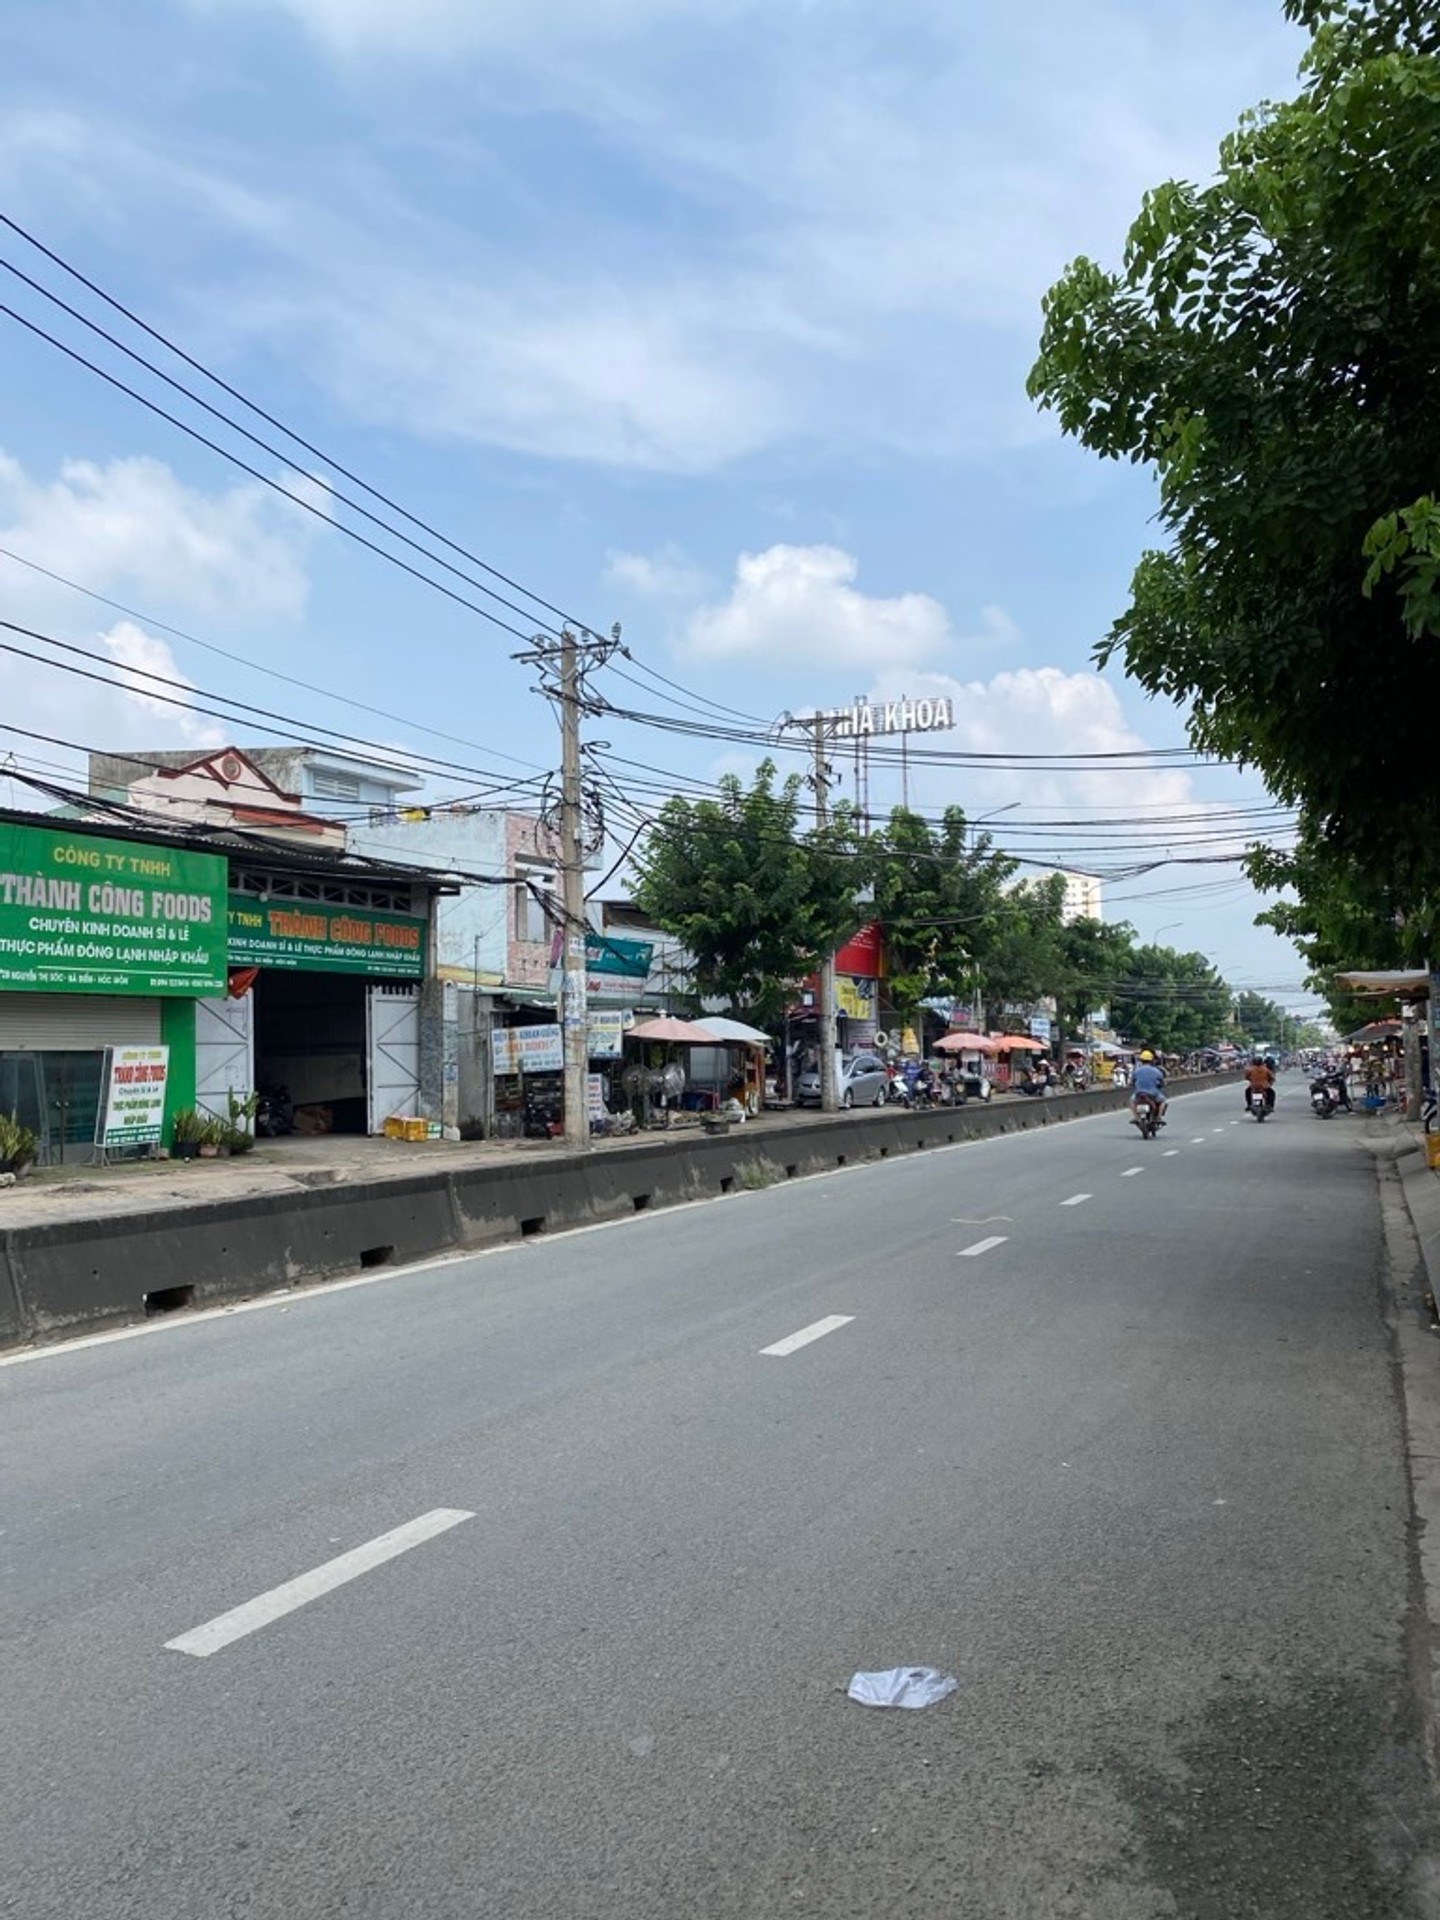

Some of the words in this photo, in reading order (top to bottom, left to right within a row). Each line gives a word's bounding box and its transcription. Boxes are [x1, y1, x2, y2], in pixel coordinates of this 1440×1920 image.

[885, 699, 949, 731] KHOA
[53, 845, 101, 867] CÔNG
[105, 854, 126, 872] TY
[130, 858, 171, 877] TNHH
[0, 870, 81, 912] THÀNH
[88, 880, 145, 918] CÔNG
[152, 891, 212, 923] FOODS
[29, 917, 80, 934] CHUYÊN
[82, 922, 110, 937] KINH
[112, 924, 153, 940] DOANH
[237, 912, 262, 928] TNHH
[268, 909, 328, 941] THÀNH
[330, 914, 371, 945] CÔNG
[374, 922, 420, 949] FOODS
[0, 939, 36, 957] THỰC
[37, 937, 75, 957] PHẨM
[77, 942, 114, 960] ĐÔNG
[116, 947, 147, 965] LẠNH
[148, 948, 179, 966] NHẬP
